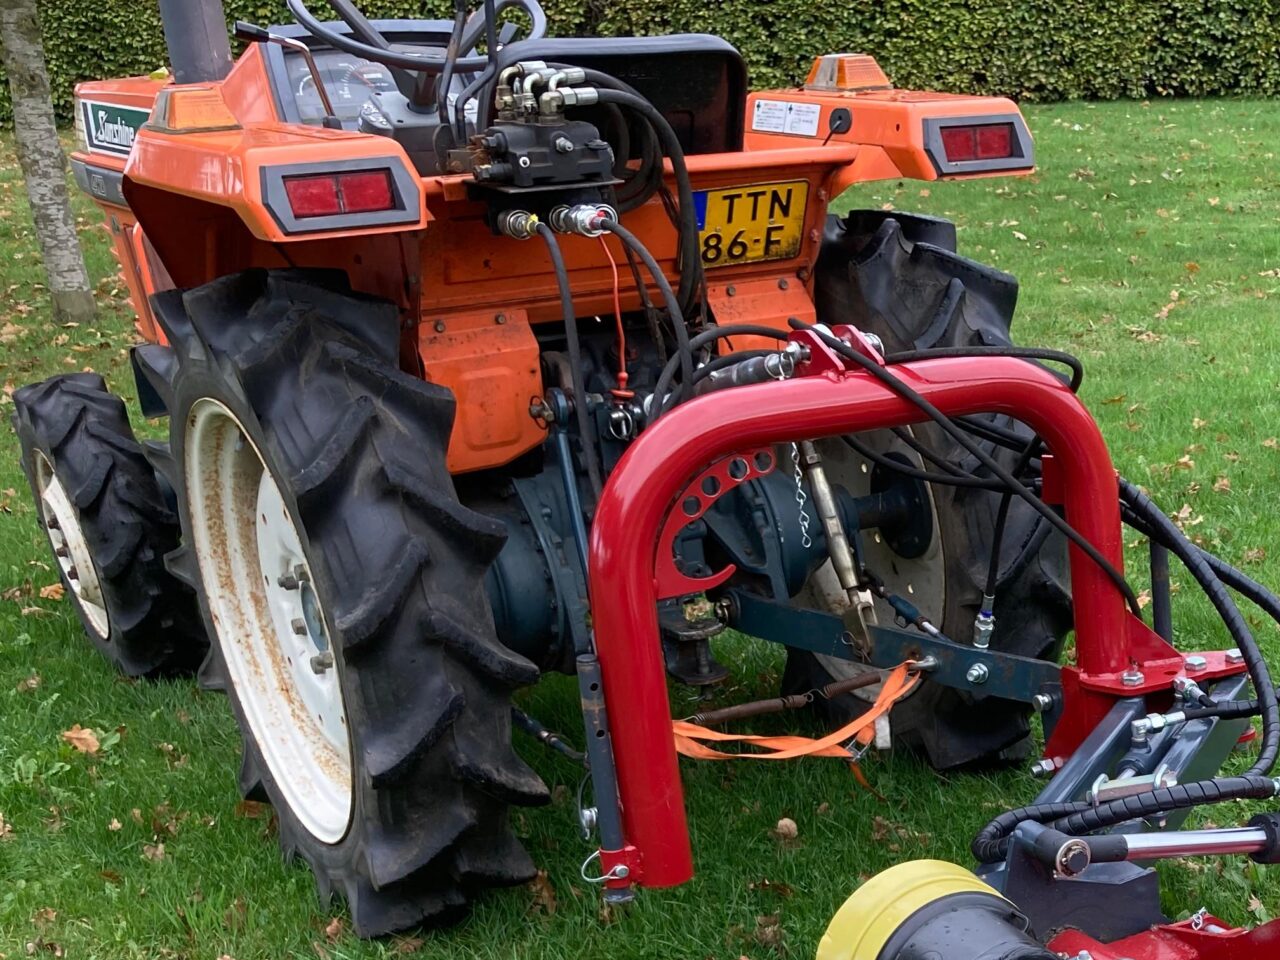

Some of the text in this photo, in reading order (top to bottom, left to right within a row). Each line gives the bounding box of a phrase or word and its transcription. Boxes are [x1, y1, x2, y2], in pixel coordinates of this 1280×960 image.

[96, 110, 135, 147] Sunshine
[722, 188, 793, 224] TTN
[701, 225, 785, 263] 86-F
